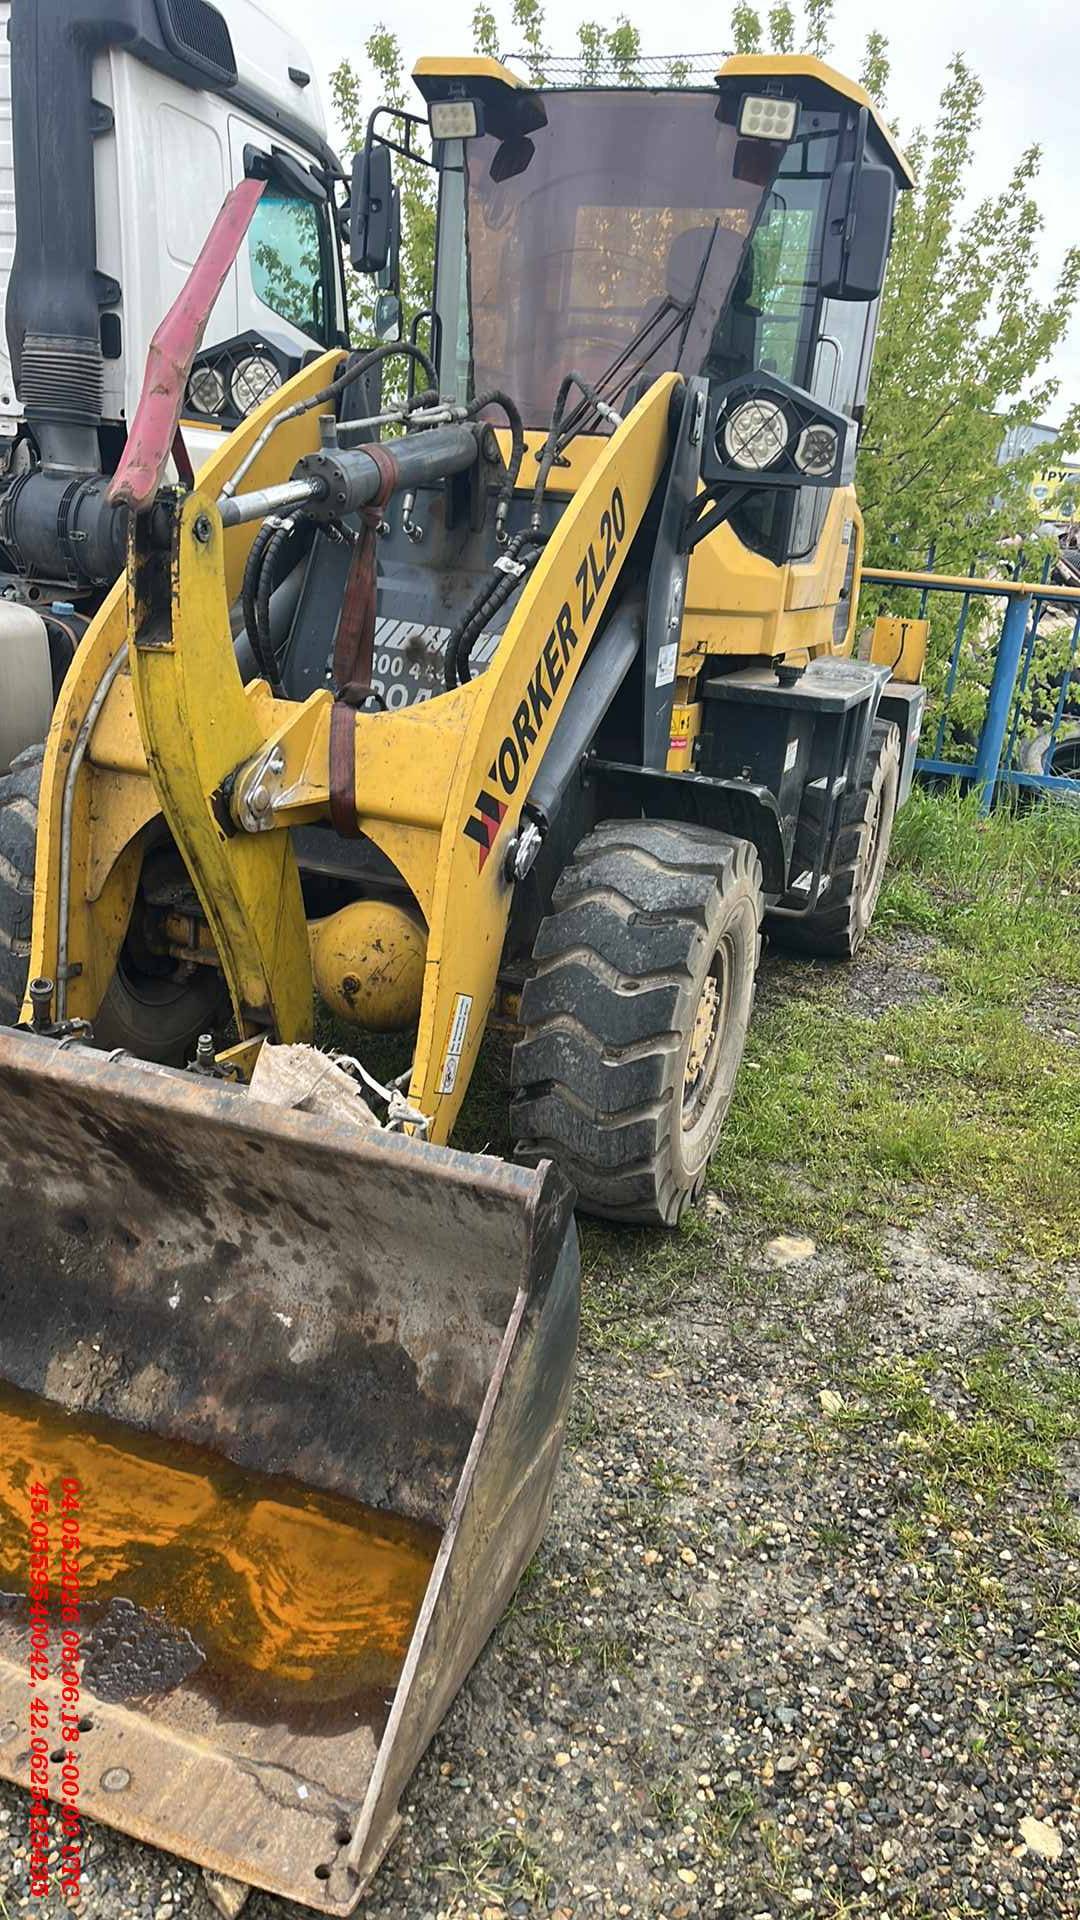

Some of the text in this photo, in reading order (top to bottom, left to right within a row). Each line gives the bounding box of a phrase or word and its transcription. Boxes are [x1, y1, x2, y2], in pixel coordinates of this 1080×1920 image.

[1040, 470, 1074, 483] ТРУ
[464, 486, 627, 874] WORKER ZL20
